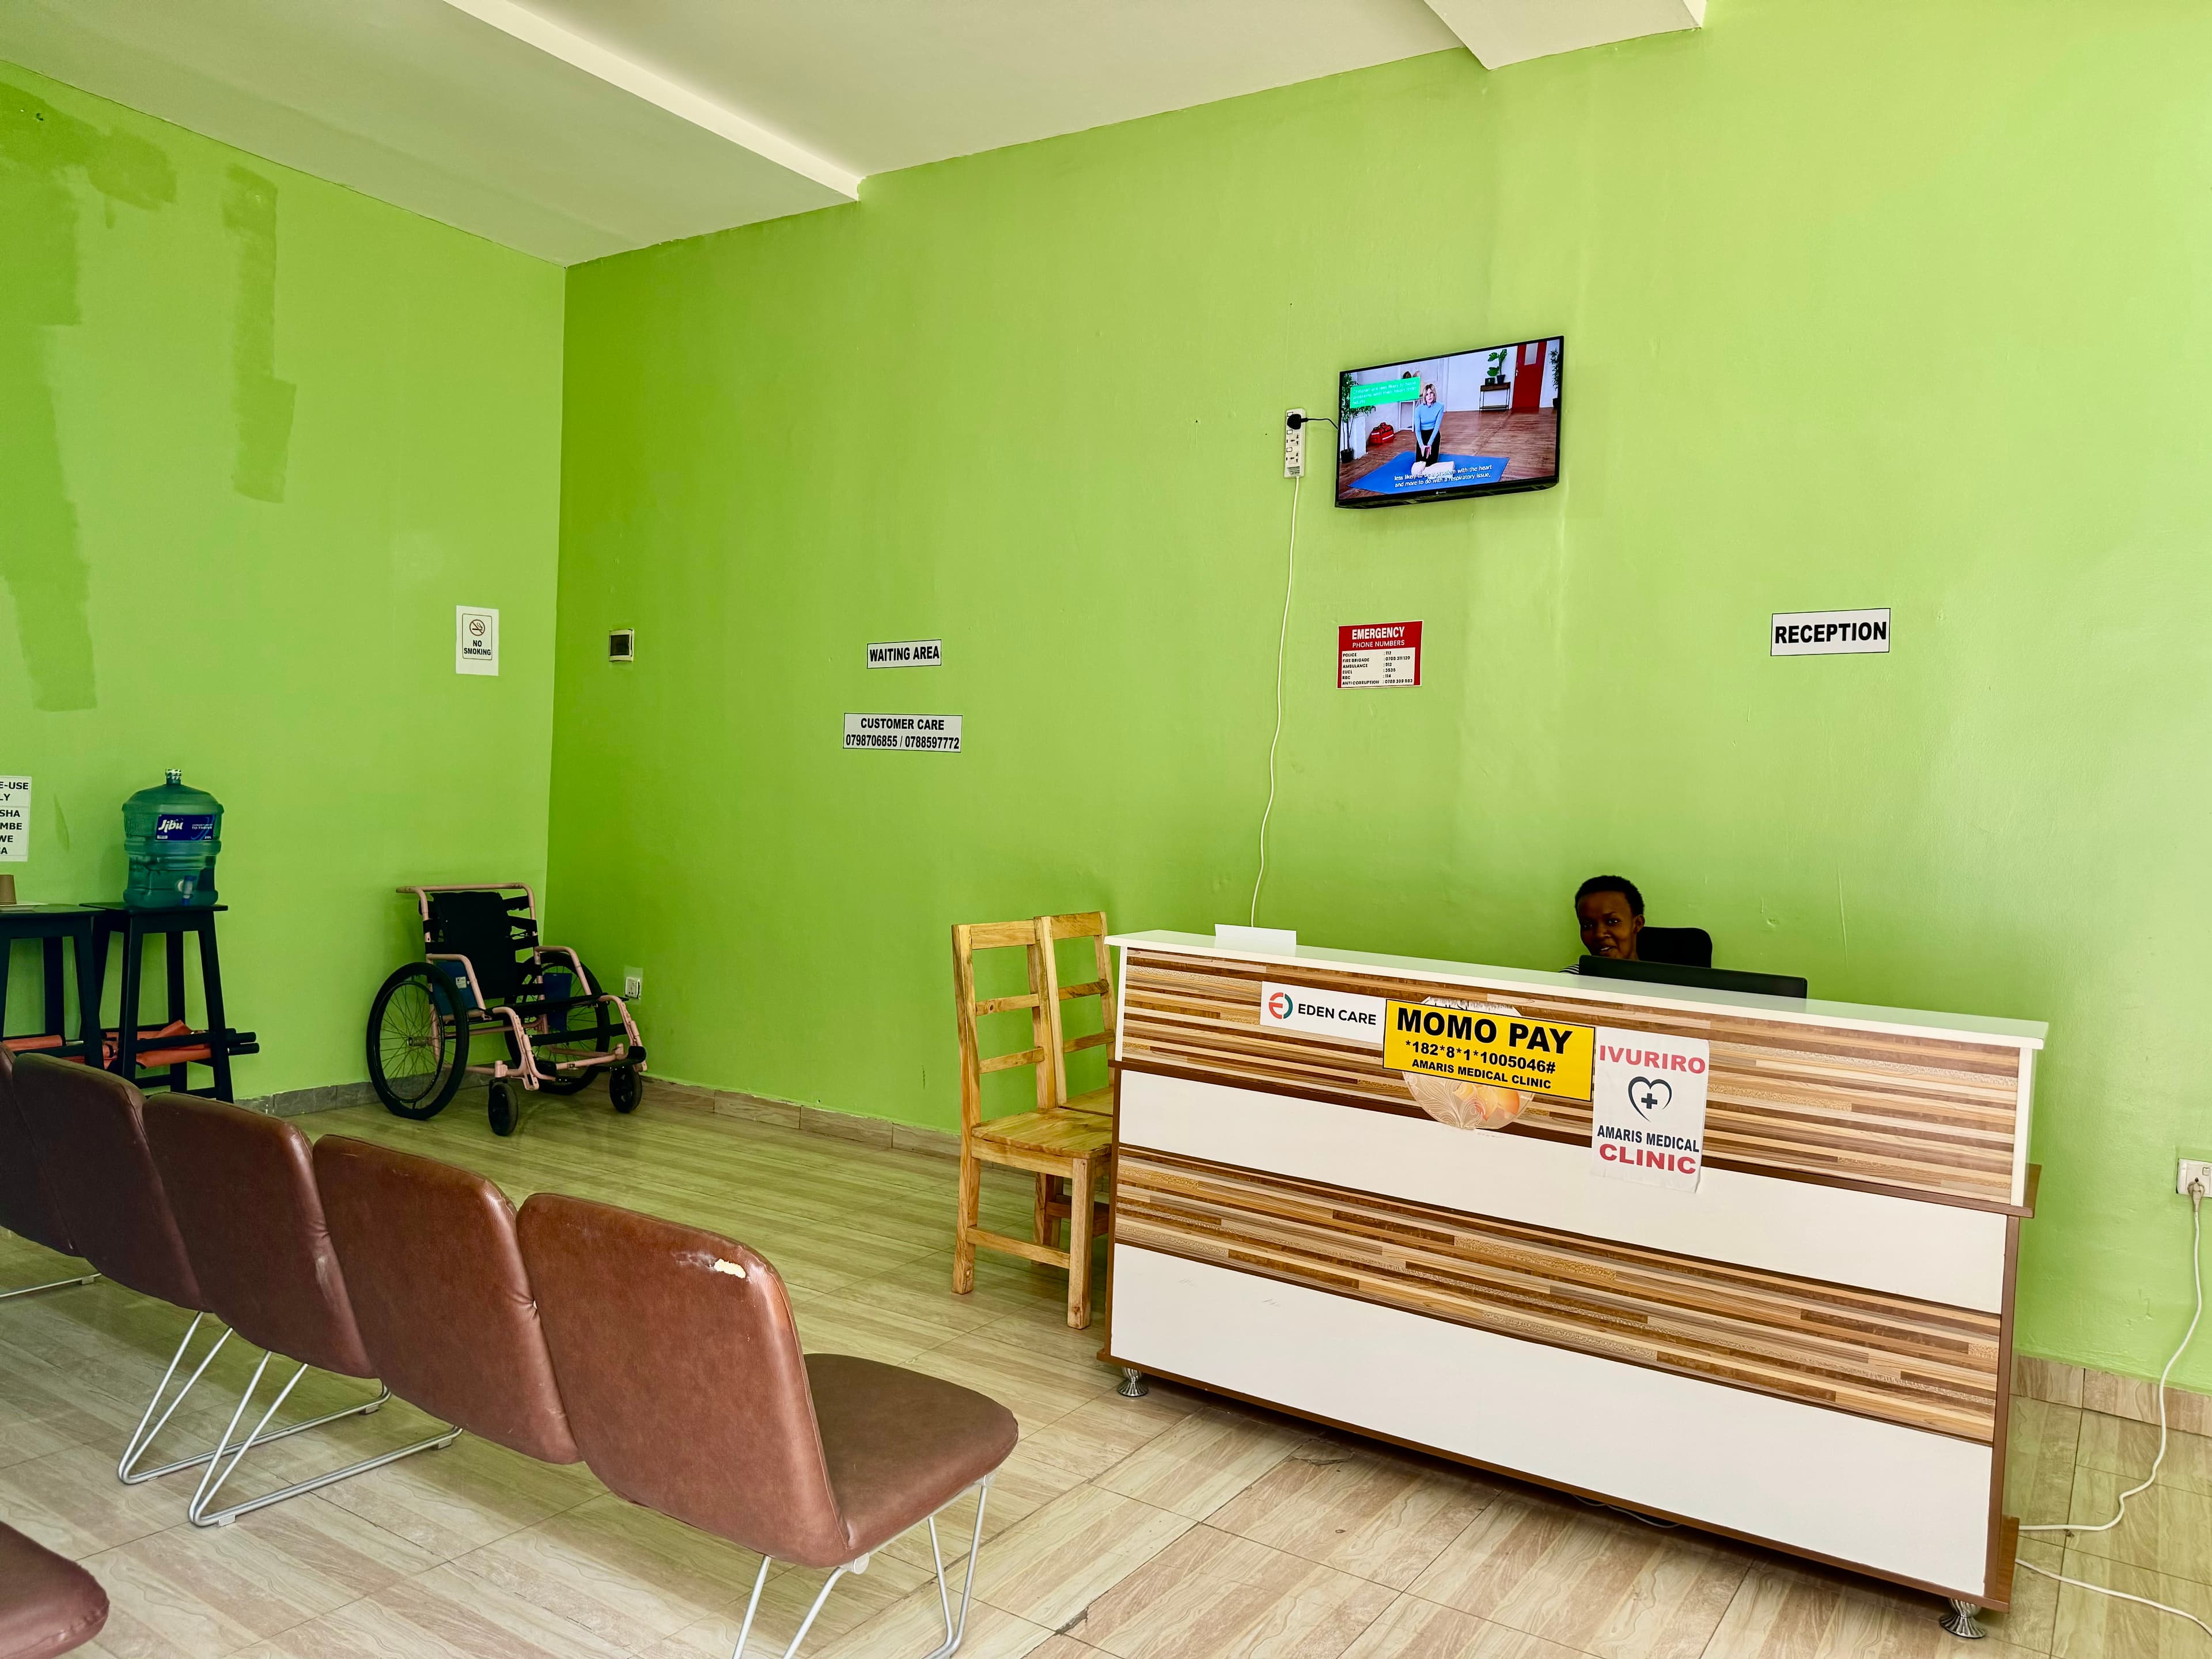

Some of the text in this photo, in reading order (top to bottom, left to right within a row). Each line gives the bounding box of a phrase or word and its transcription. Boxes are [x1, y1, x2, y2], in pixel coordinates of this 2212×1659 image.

[1352, 626, 1405, 640] EMERGENCY
[1775, 622, 1887, 644] RECEPTION
[464, 647, 491, 656] SMOKING
[472, 639, 483, 647] NO
[869, 645, 940, 662] WAITING AREA
[861, 718, 945, 730] CUSTOMER CARE
[846, 733, 898, 747] 0798706855
[905, 735, 960, 749] 0788597772
[0, 809, 21, 817] SHA
[158, 819, 184, 833] Jibu
[1298, 1003, 1377, 1025] EDEN CARE
[1397, 1007, 1573, 1055] MOMO PAY
[1600, 1045, 1706, 1074] IVURIRO
[1412, 1059, 1551, 1089] AMARIS MEDICAL CLINIC
[1597, 1125, 1699, 1153] AMARIS MEDICAL
[1599, 1143, 1696, 1175] CLINIC
